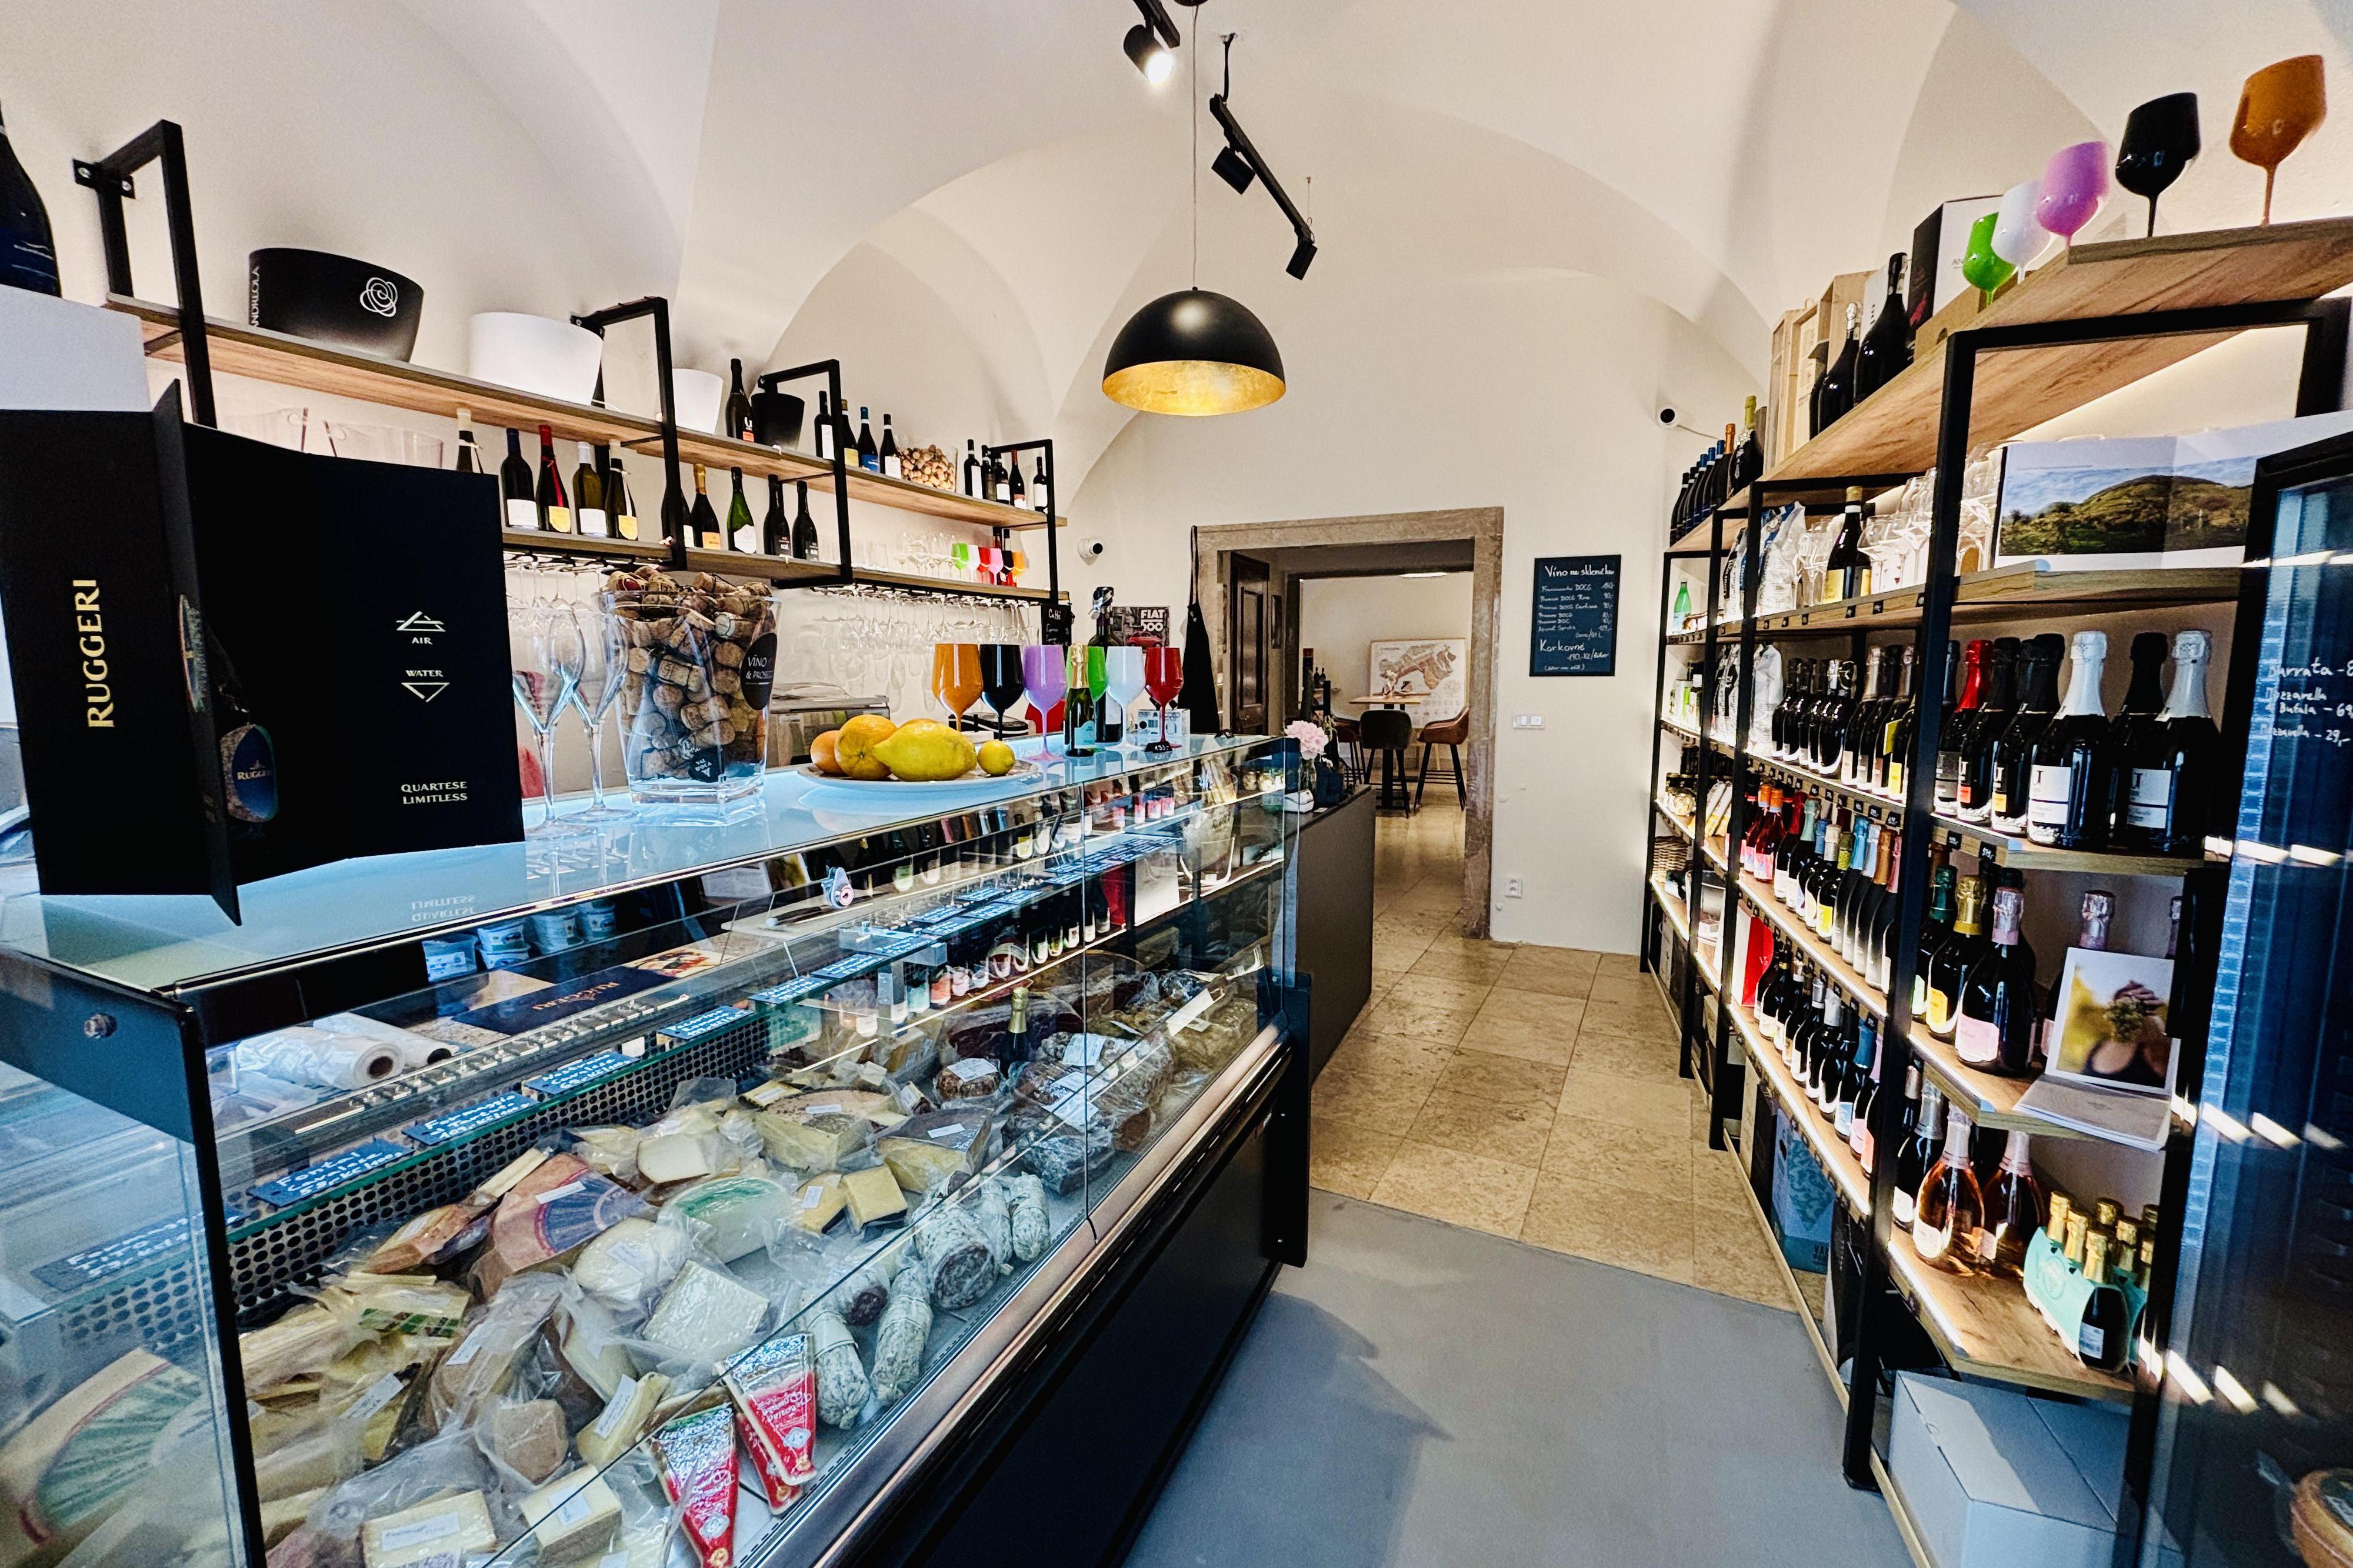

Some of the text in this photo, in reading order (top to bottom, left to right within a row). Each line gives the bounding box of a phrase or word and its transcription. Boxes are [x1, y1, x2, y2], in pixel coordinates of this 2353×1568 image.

[1545, 565, 1568, 577] Víno
[1141, 609, 1165, 619] FIAT
[1141, 619, 1164, 632] 500
[1539, 639, 1585, 652] Korkovné
[72, 580, 115, 728] RUGGERI
[401, 781, 468, 793] QUARTESE
[402, 793, 468, 805] LIMITLESS
[424, 1095, 516, 1130] Formaggio
[276, 1152, 361, 1187] Fontal
[288, 1152, 383, 1192] Cavalese
